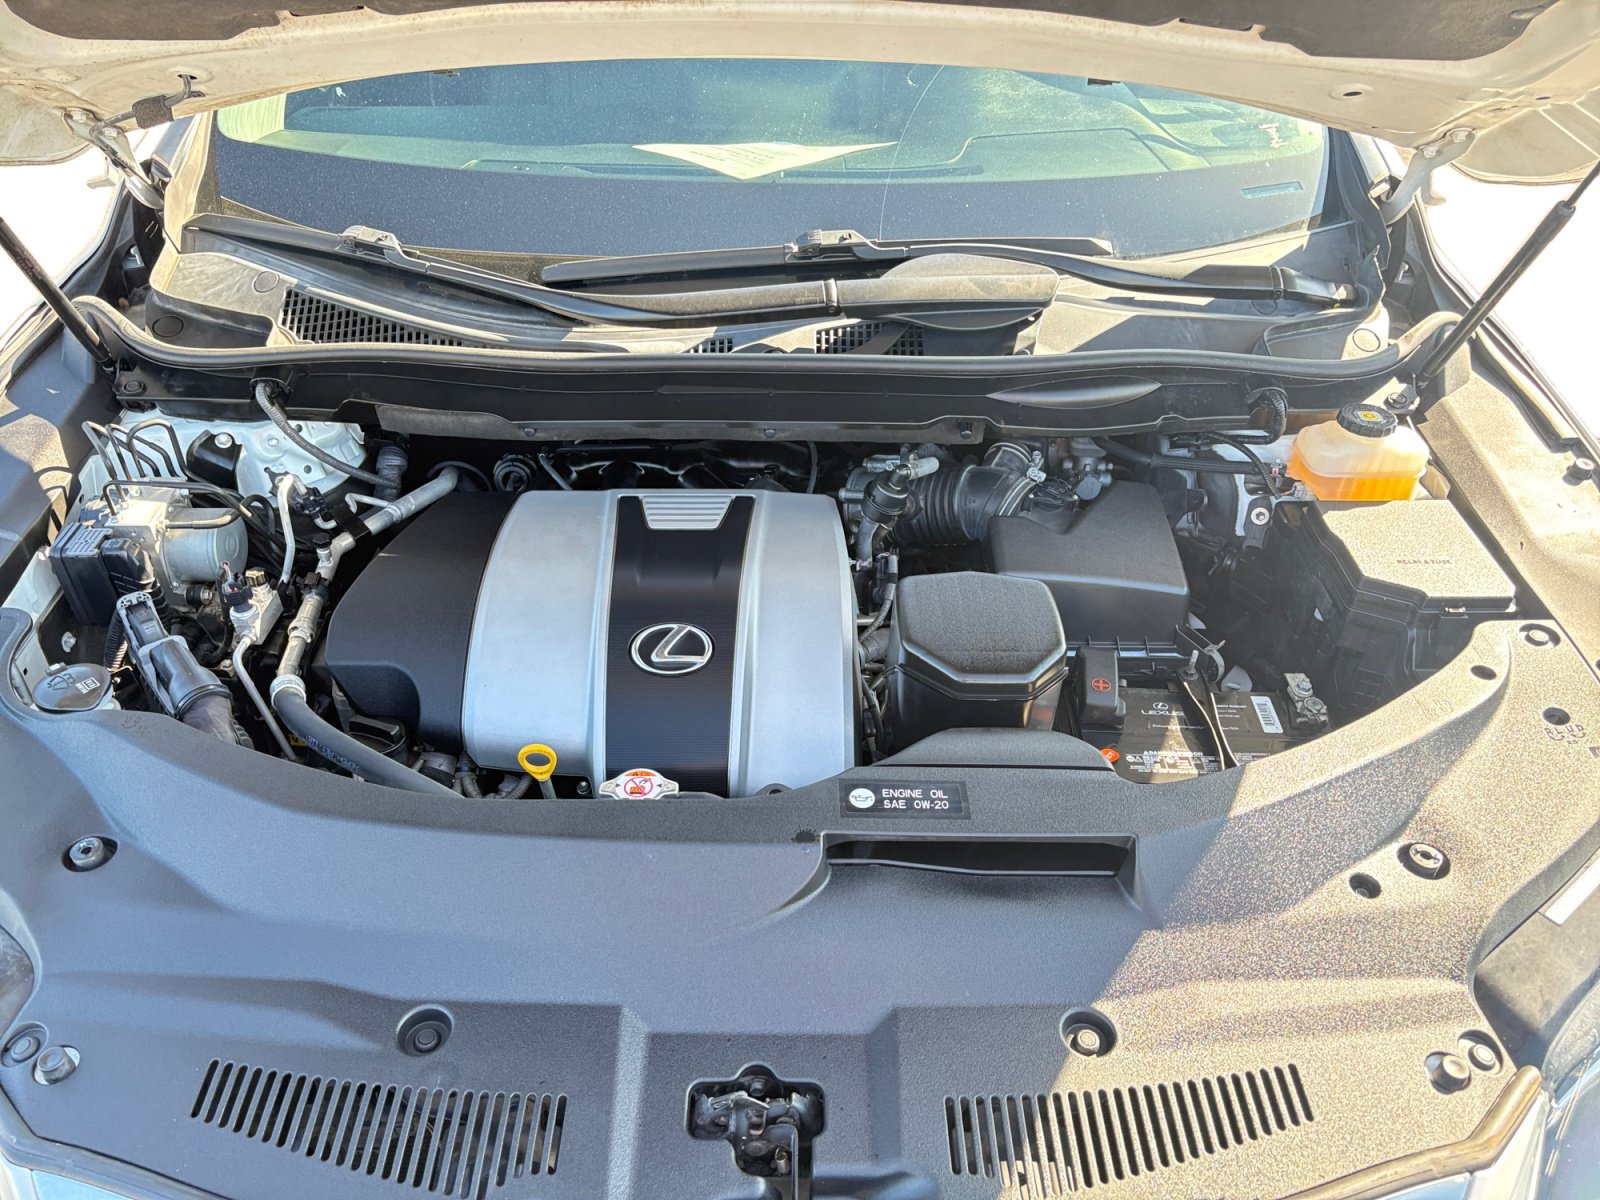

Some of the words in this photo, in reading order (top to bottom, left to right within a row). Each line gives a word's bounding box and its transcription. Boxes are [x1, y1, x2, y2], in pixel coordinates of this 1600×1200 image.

[882, 788, 923, 798] ENGINE
[930, 789, 948, 799] OIL
[883, 799, 907, 809] SAE
[914, 800, 949, 809] 0W-20
